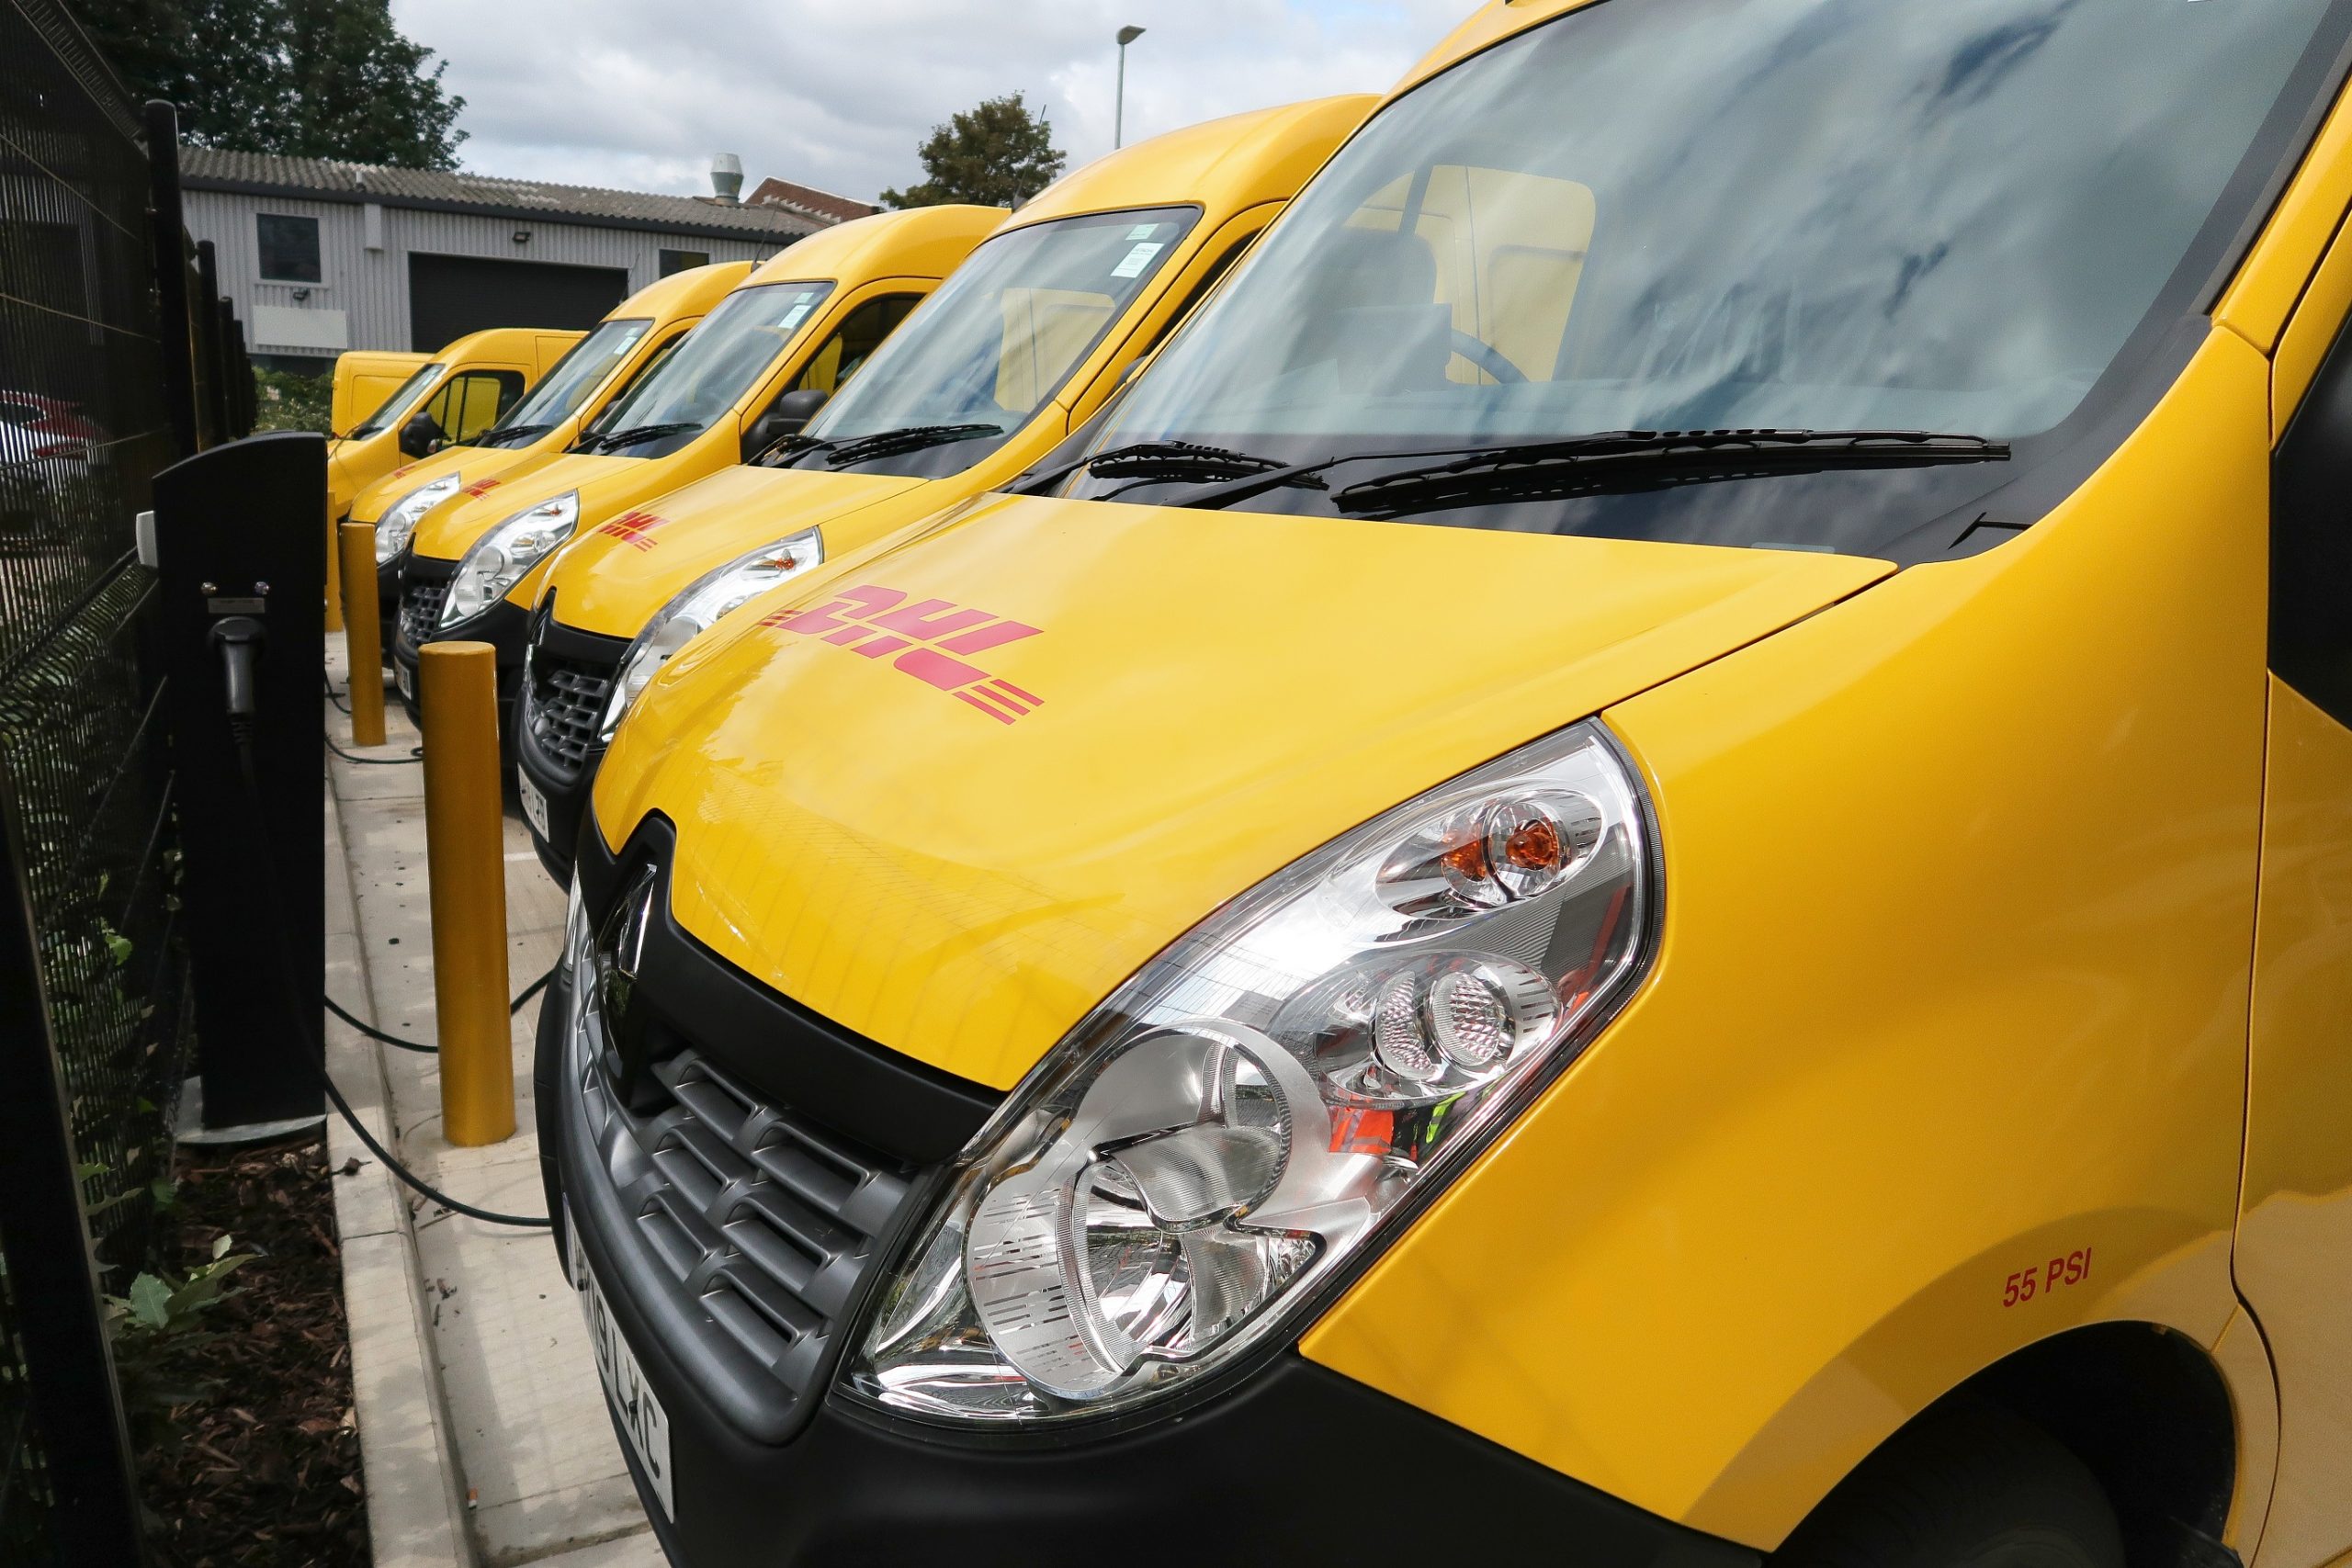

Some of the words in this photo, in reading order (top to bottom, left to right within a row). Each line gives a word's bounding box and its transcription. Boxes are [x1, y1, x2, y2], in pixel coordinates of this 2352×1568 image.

[775, 585, 1045, 692] DHL
[2003, 1267, 2038, 1307] 55
[2045, 1247, 2092, 1293] PSI
[611, 1326, 661, 1480] LXC
